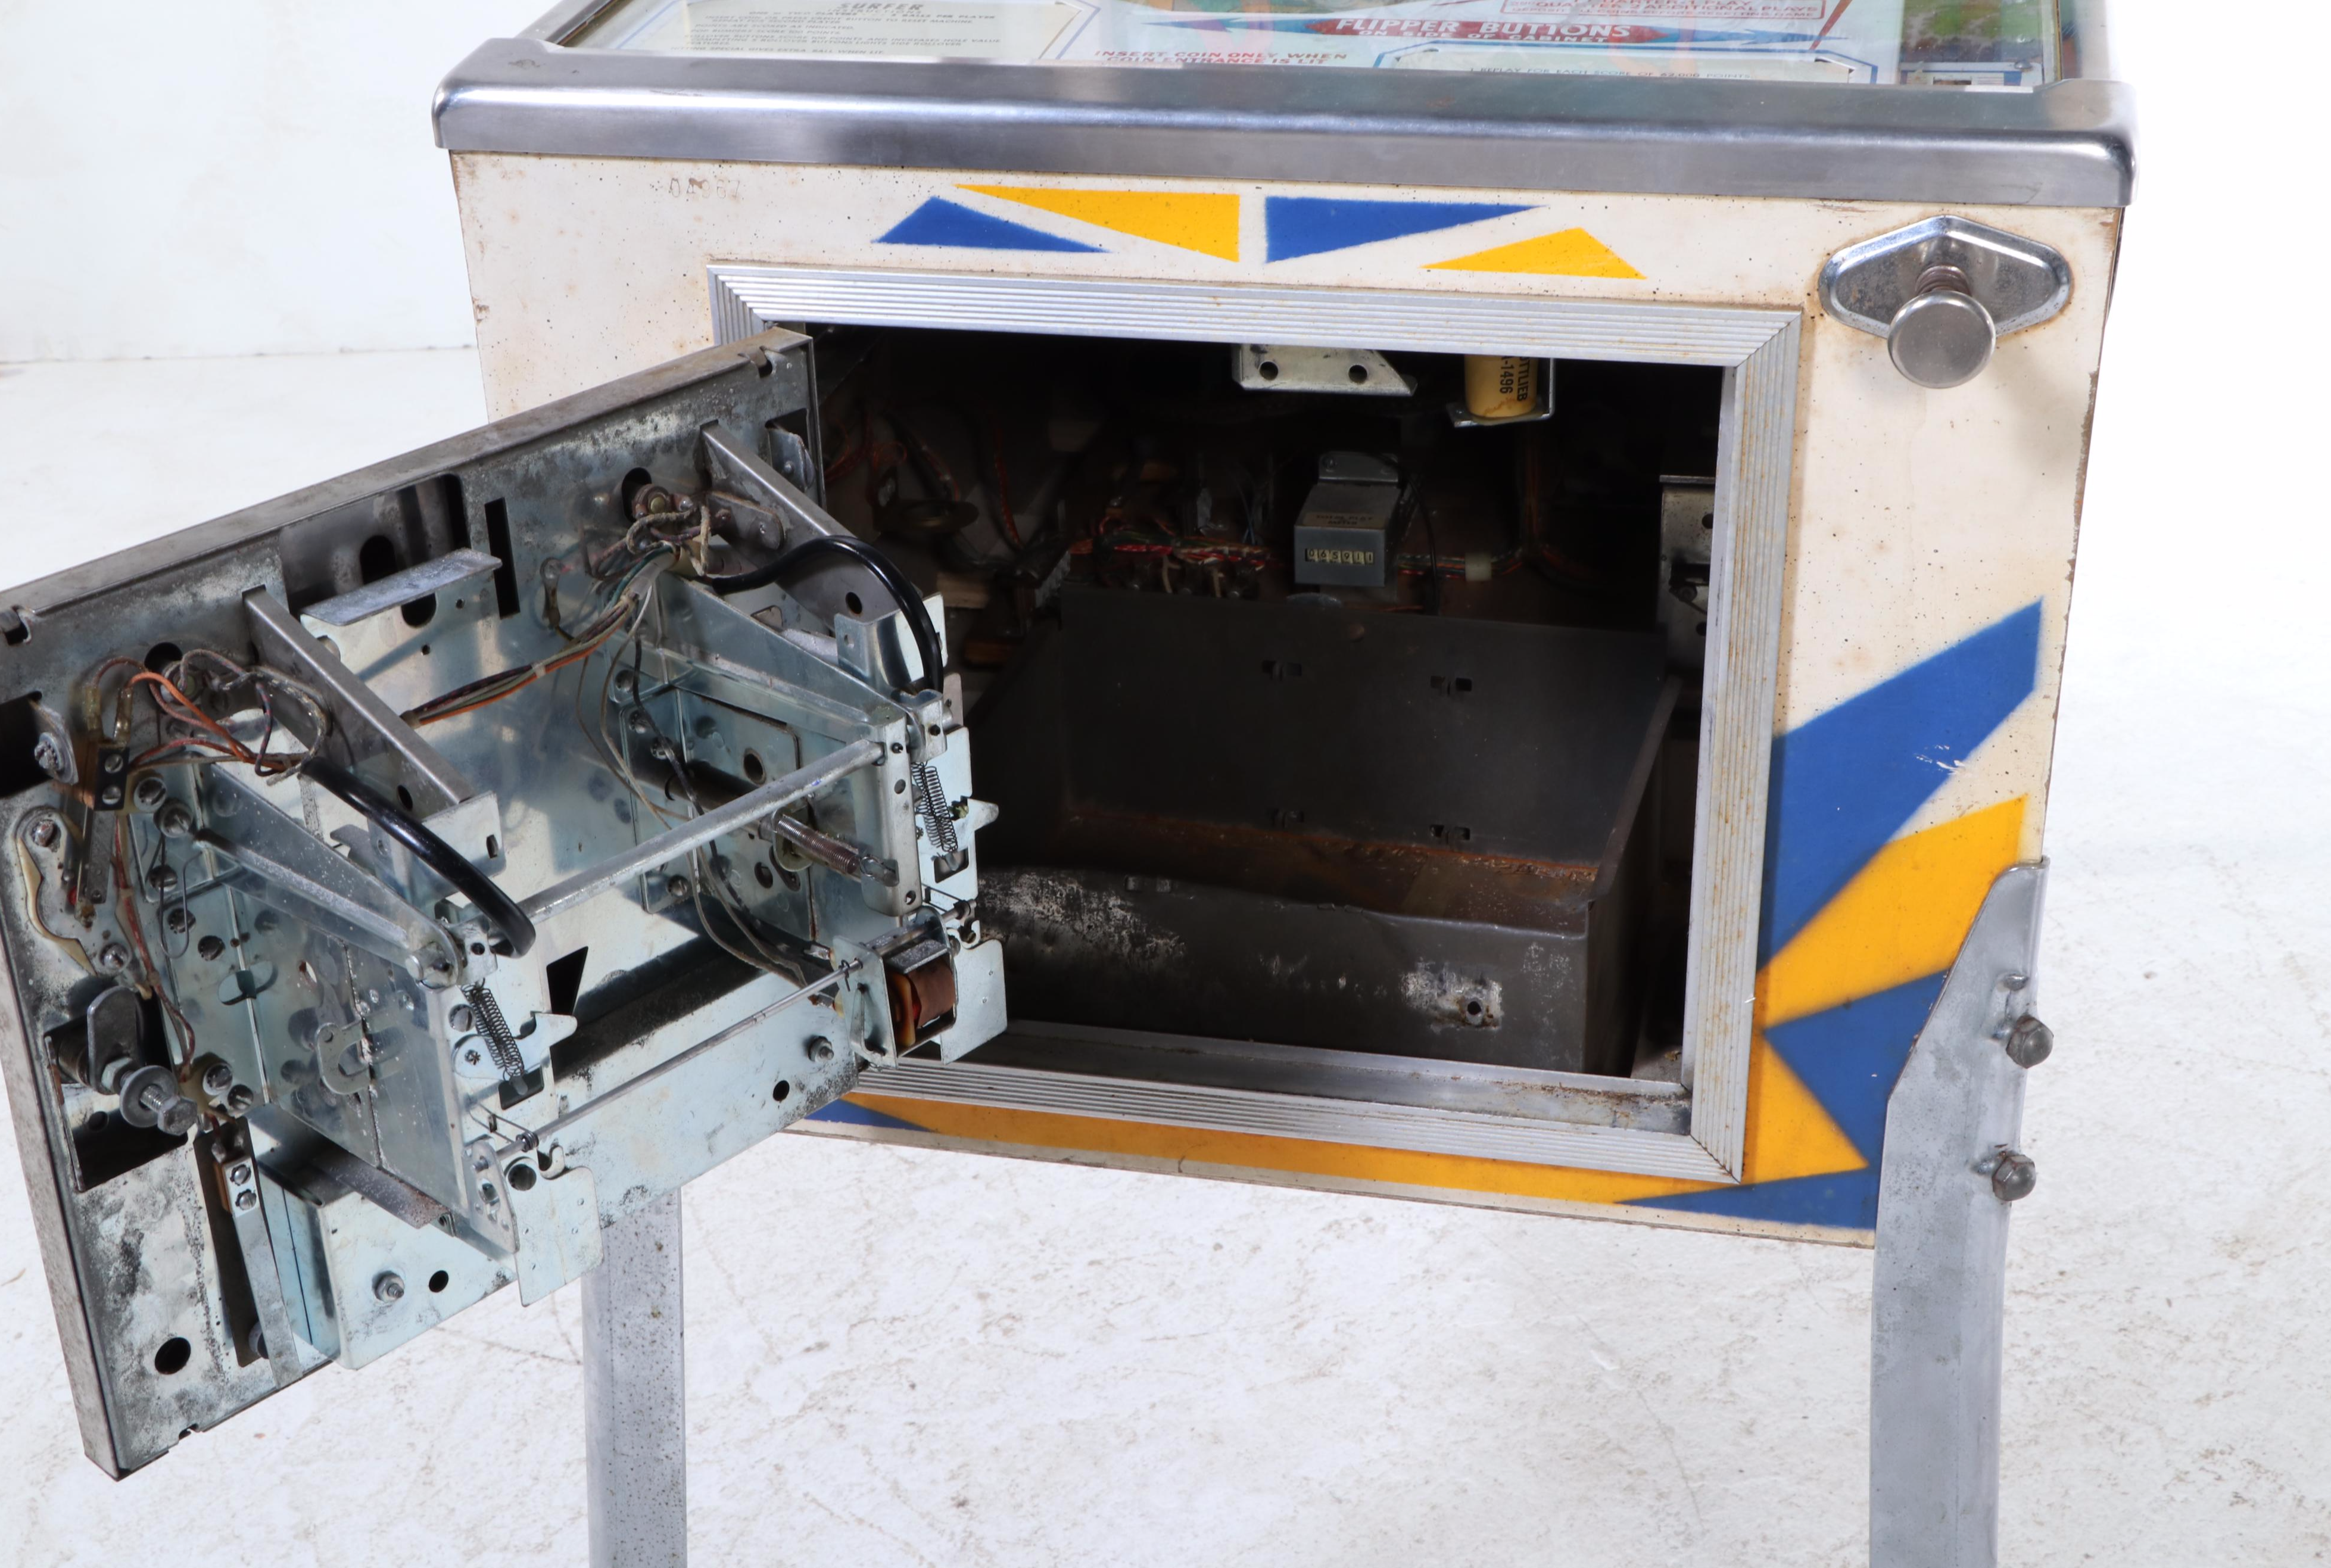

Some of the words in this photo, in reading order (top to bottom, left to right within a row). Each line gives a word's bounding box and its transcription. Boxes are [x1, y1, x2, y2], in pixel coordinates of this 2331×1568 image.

[1336, 19, 1459, 32] FLIPPER
[1479, 23, 1631, 37] BUTTONS
[1509, 35, 1609, 43] CABINET
